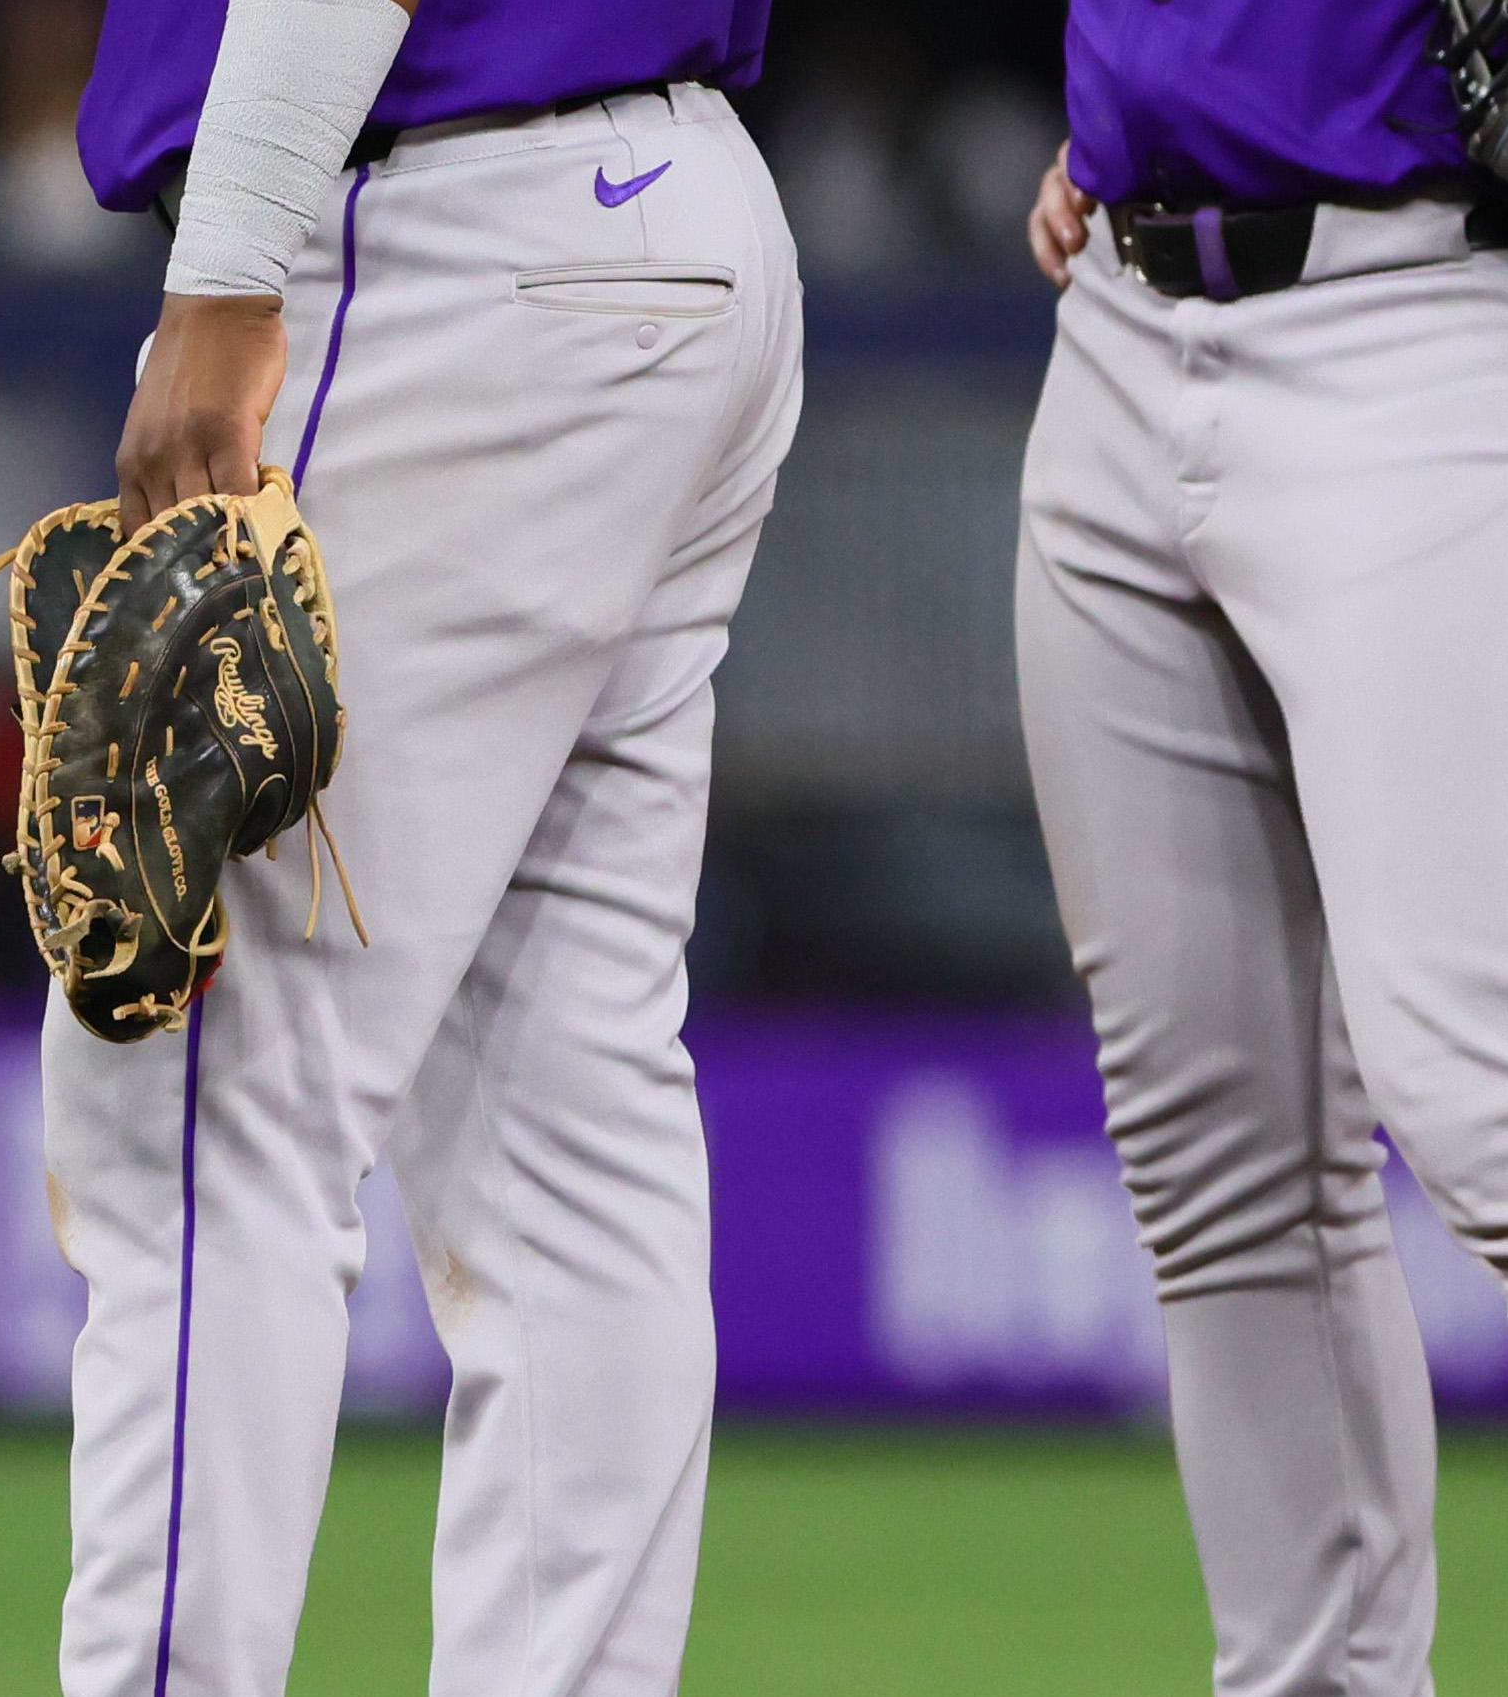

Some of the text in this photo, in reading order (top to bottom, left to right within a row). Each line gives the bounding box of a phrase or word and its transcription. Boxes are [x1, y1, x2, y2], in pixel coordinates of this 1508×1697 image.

[210, 636, 279, 761] Rawlings
[154, 783, 174, 828] GOLD
[162, 826, 186, 877] GLOVE
